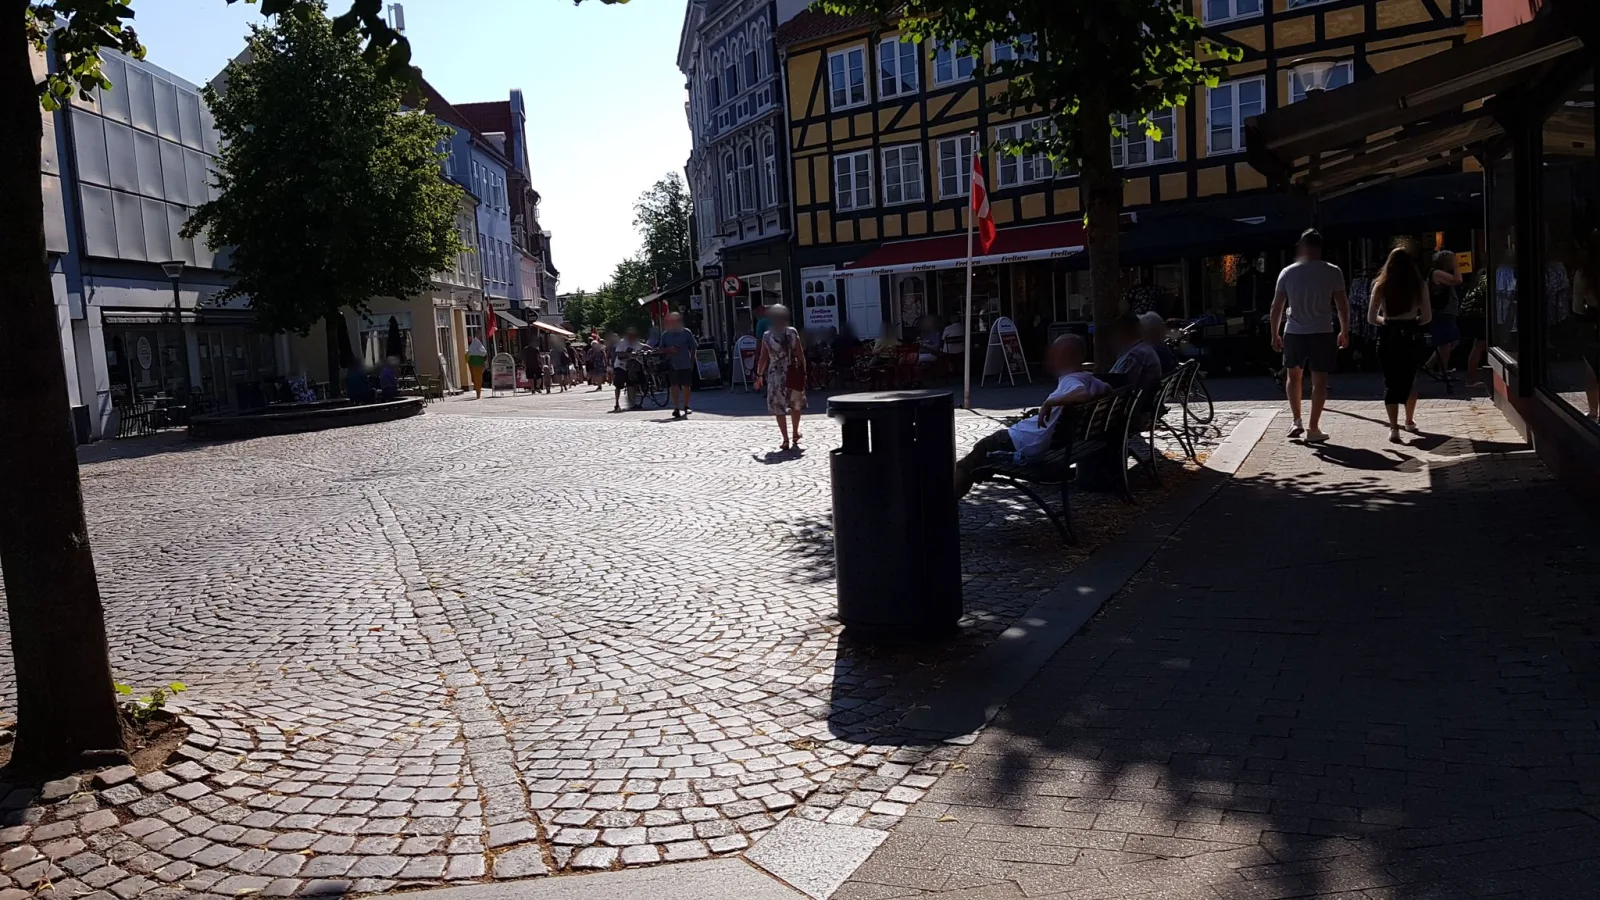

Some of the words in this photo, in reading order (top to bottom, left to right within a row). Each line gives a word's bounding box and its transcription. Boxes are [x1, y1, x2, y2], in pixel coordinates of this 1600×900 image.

[955, 259, 981, 267] Frelsen
[1001, 255, 1028, 263] Frellsen
[1050, 250, 1079, 258] Frellsen
